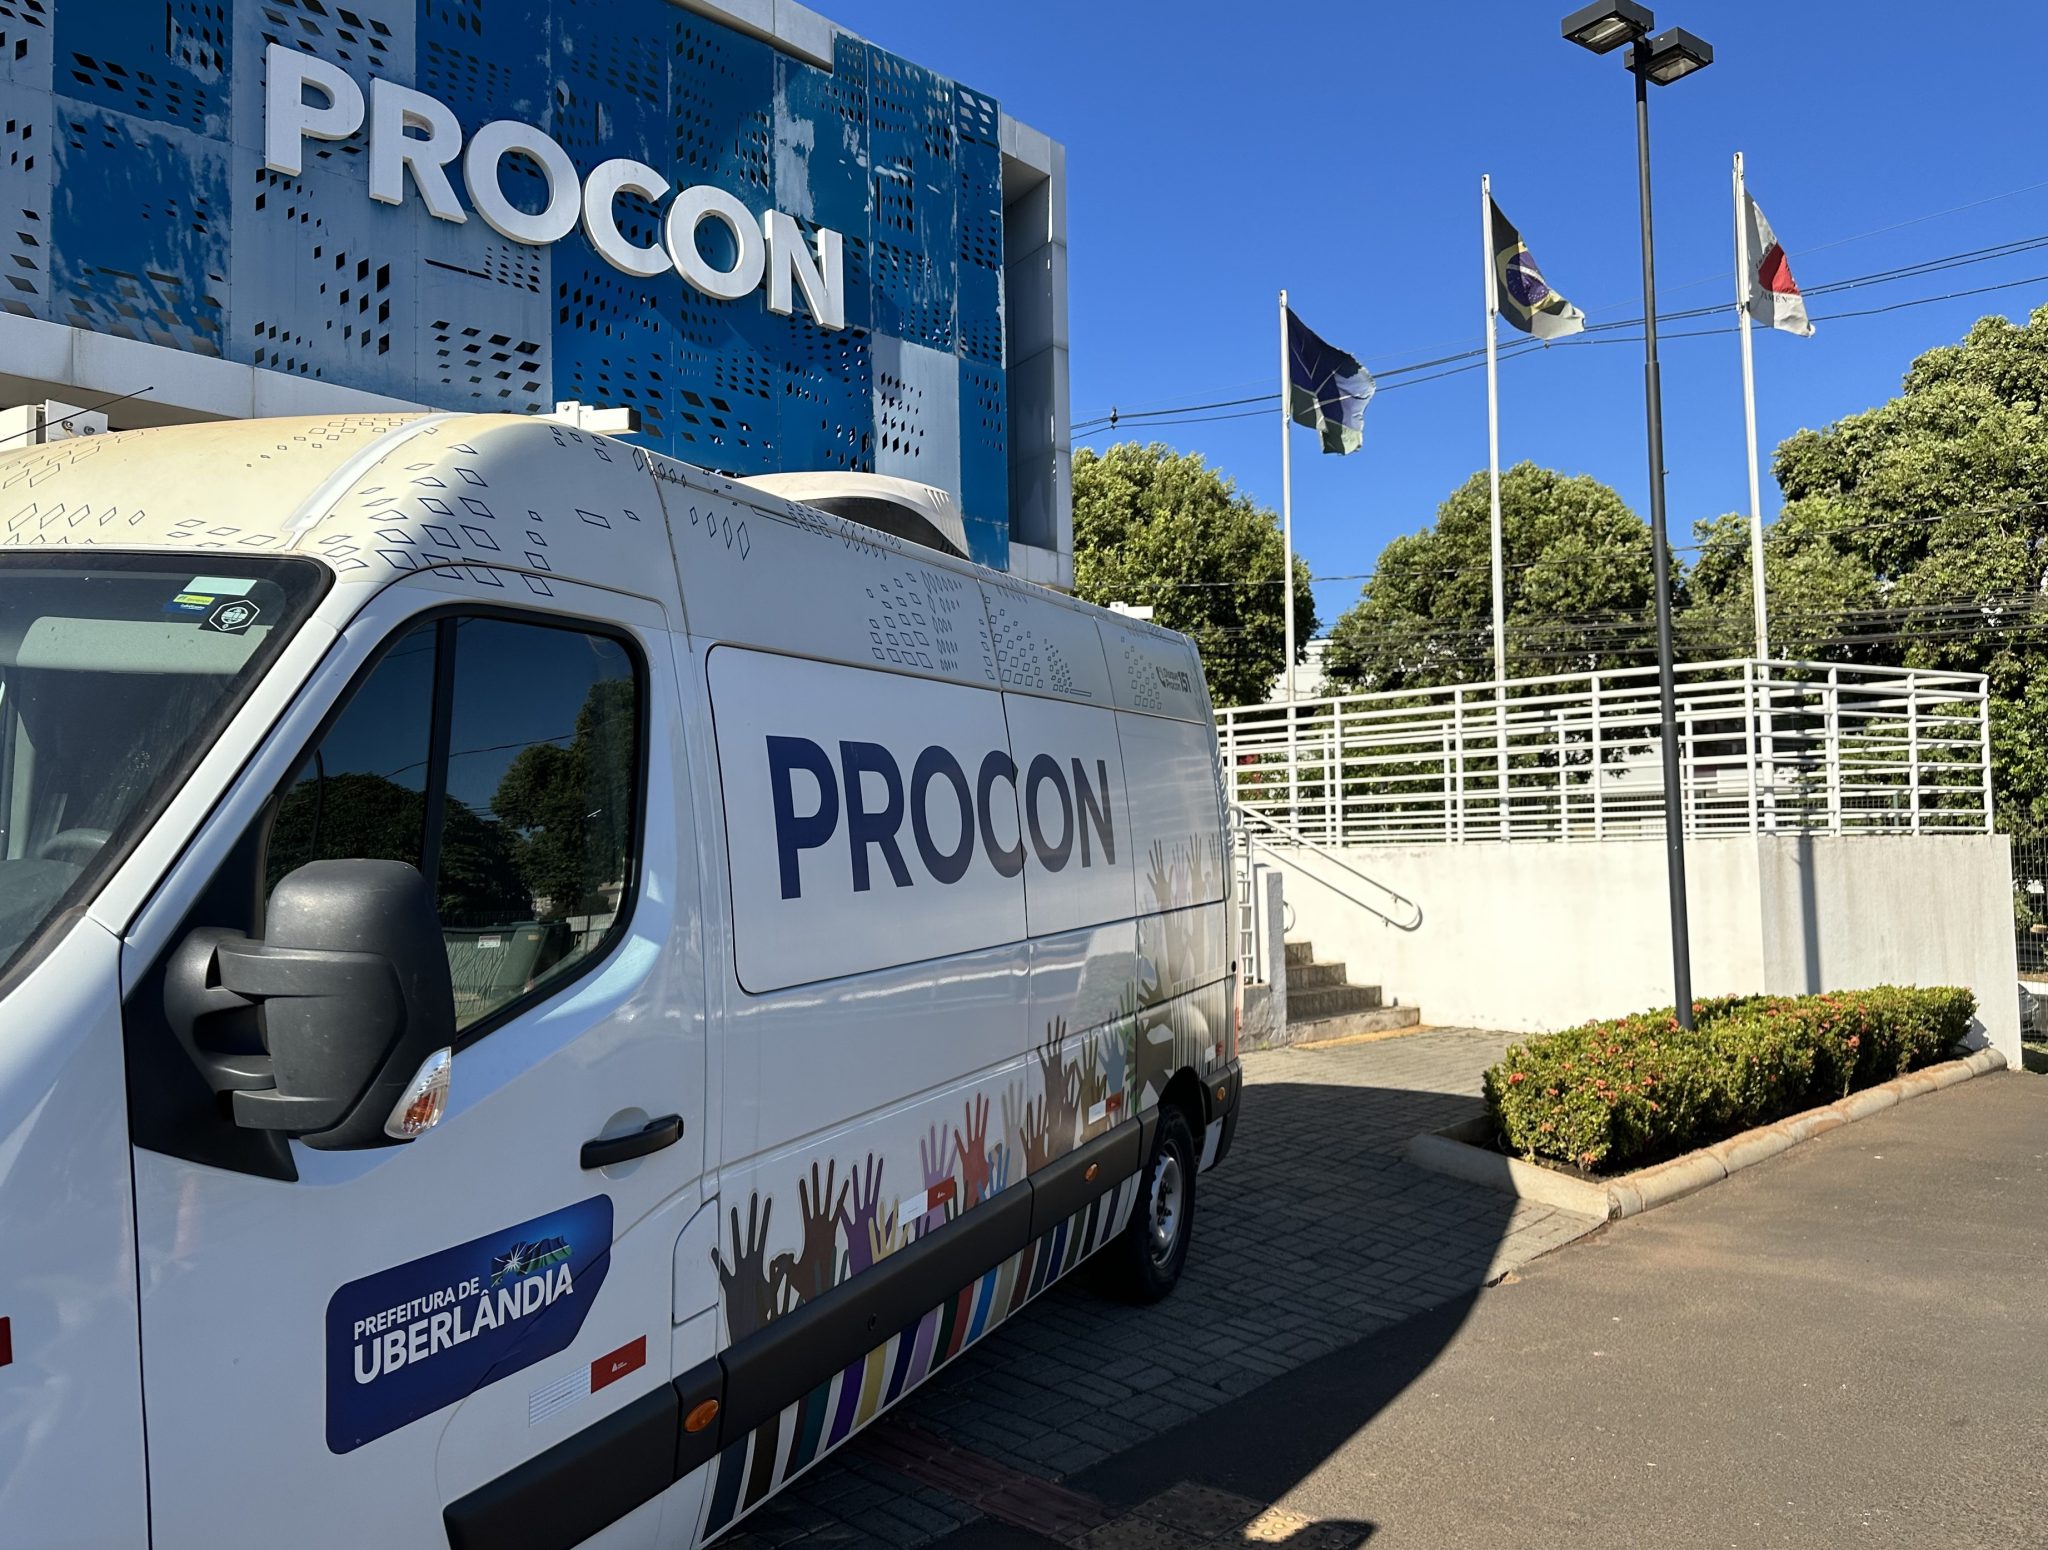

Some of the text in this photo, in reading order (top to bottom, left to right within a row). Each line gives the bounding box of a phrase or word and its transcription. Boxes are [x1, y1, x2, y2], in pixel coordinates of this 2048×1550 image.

[265, 42, 844, 332] PROCON
[765, 735, 1116, 900] PROCON
[354, 1276, 480, 1341] PREFEITURA DE
[354, 1262, 574, 1385] UBERLÂNDIA
